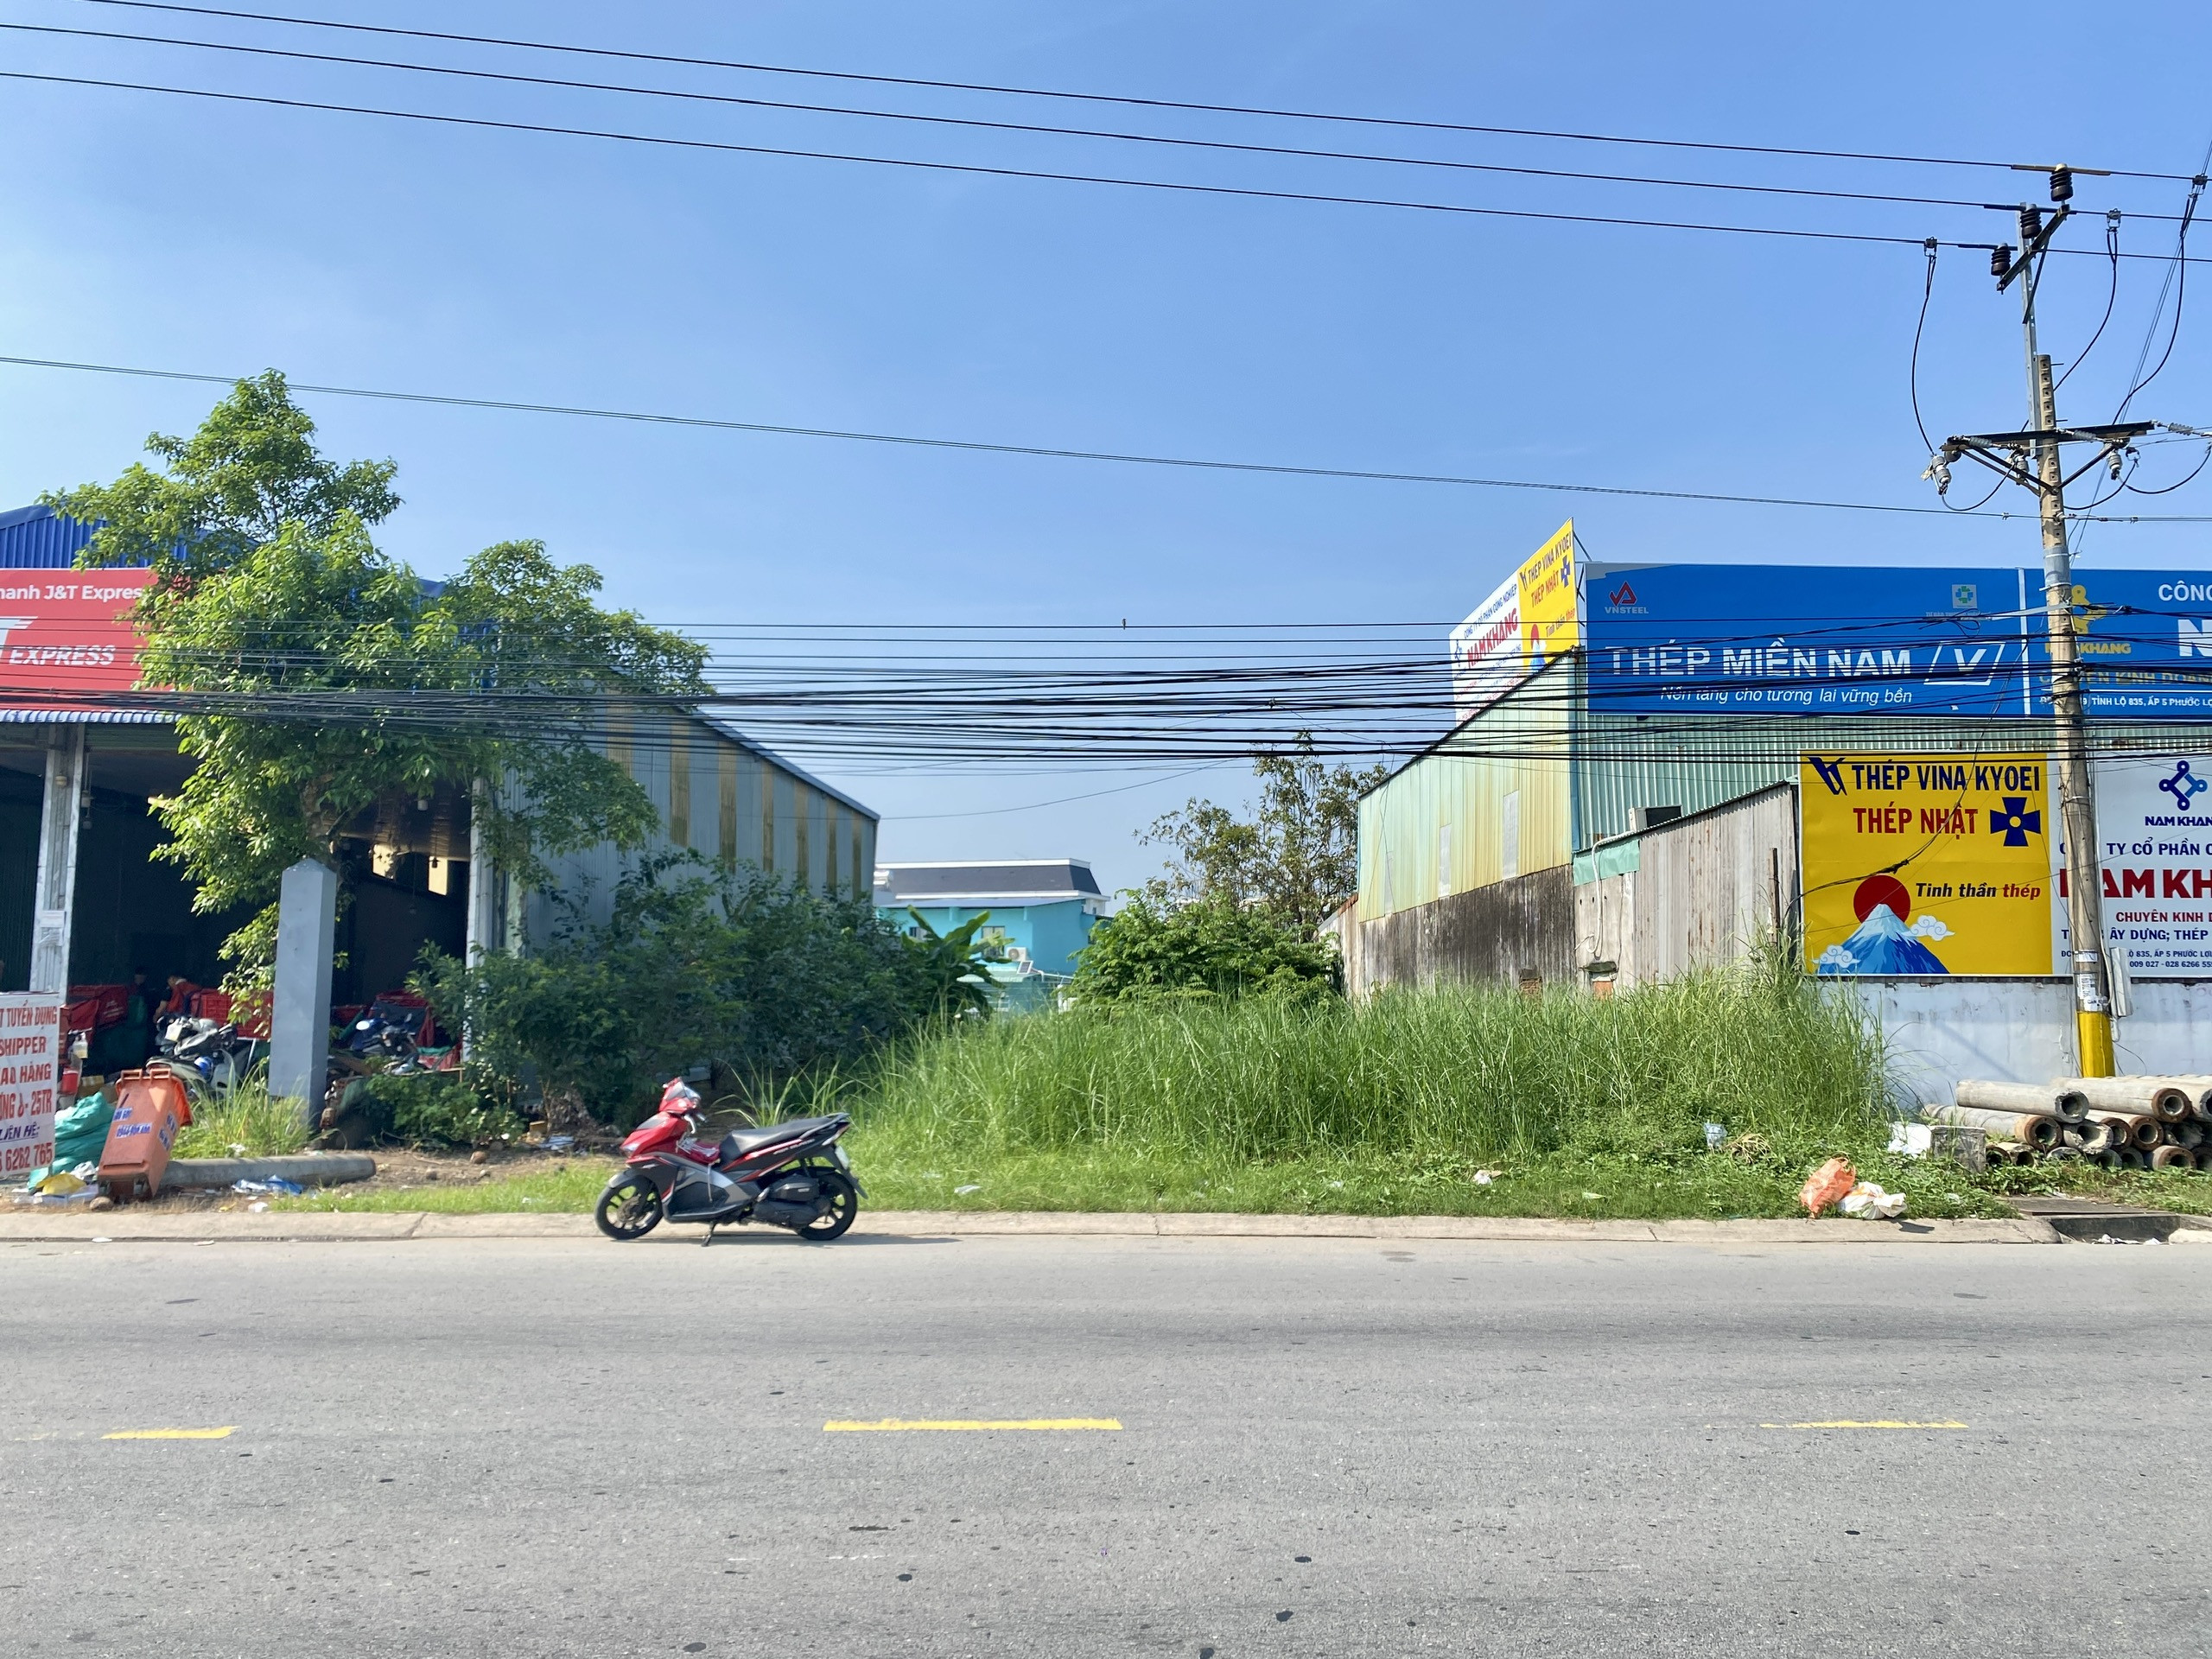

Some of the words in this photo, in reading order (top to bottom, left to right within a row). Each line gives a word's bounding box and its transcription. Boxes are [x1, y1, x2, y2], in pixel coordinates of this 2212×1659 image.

[44, 586, 78, 600] J&T
[9, 645, 116, 665] EXPRESS
[1605, 639, 1710, 675] THÉP
[1723, 638, 1816, 677] MIỀN
[1827, 649, 1911, 677] NAM
[1735, 688, 1762, 702] cho
[1819, 688, 1836, 702] lai
[1841, 689, 1878, 706] vững
[1885, 687, 1912, 703] bền
[2114, 696, 2126, 707] LỘ
[2147, 695, 2160, 706] ẤP
[1852, 759, 1910, 790] THÉP
[1916, 766, 1968, 791] VINA
[1975, 766, 2040, 791] KYOEI
[1853, 801, 1912, 834] THÉP
[1921, 803, 1978, 839] NHẬT
[2145, 817, 2175, 826] NAM
[2106, 843, 2126, 855] TY
[2132, 837, 2153, 855] CỔ
[2158, 838, 2200, 855] PHẦN
[1916, 882, 1953, 898] Tinh
[1959, 883, 1997, 898] thần
[2003, 883, 2041, 900] thép
[2116, 909, 2168, 922] CHUYÊN
[2172, 912, 2203, 922] KINH
[2131, 928, 2170, 943] DỰNG;
[2174, 927, 2209, 940] THÉP
[0, 1036, 47, 1057] SHIPPER
[34, 1142, 53, 1166] 765
